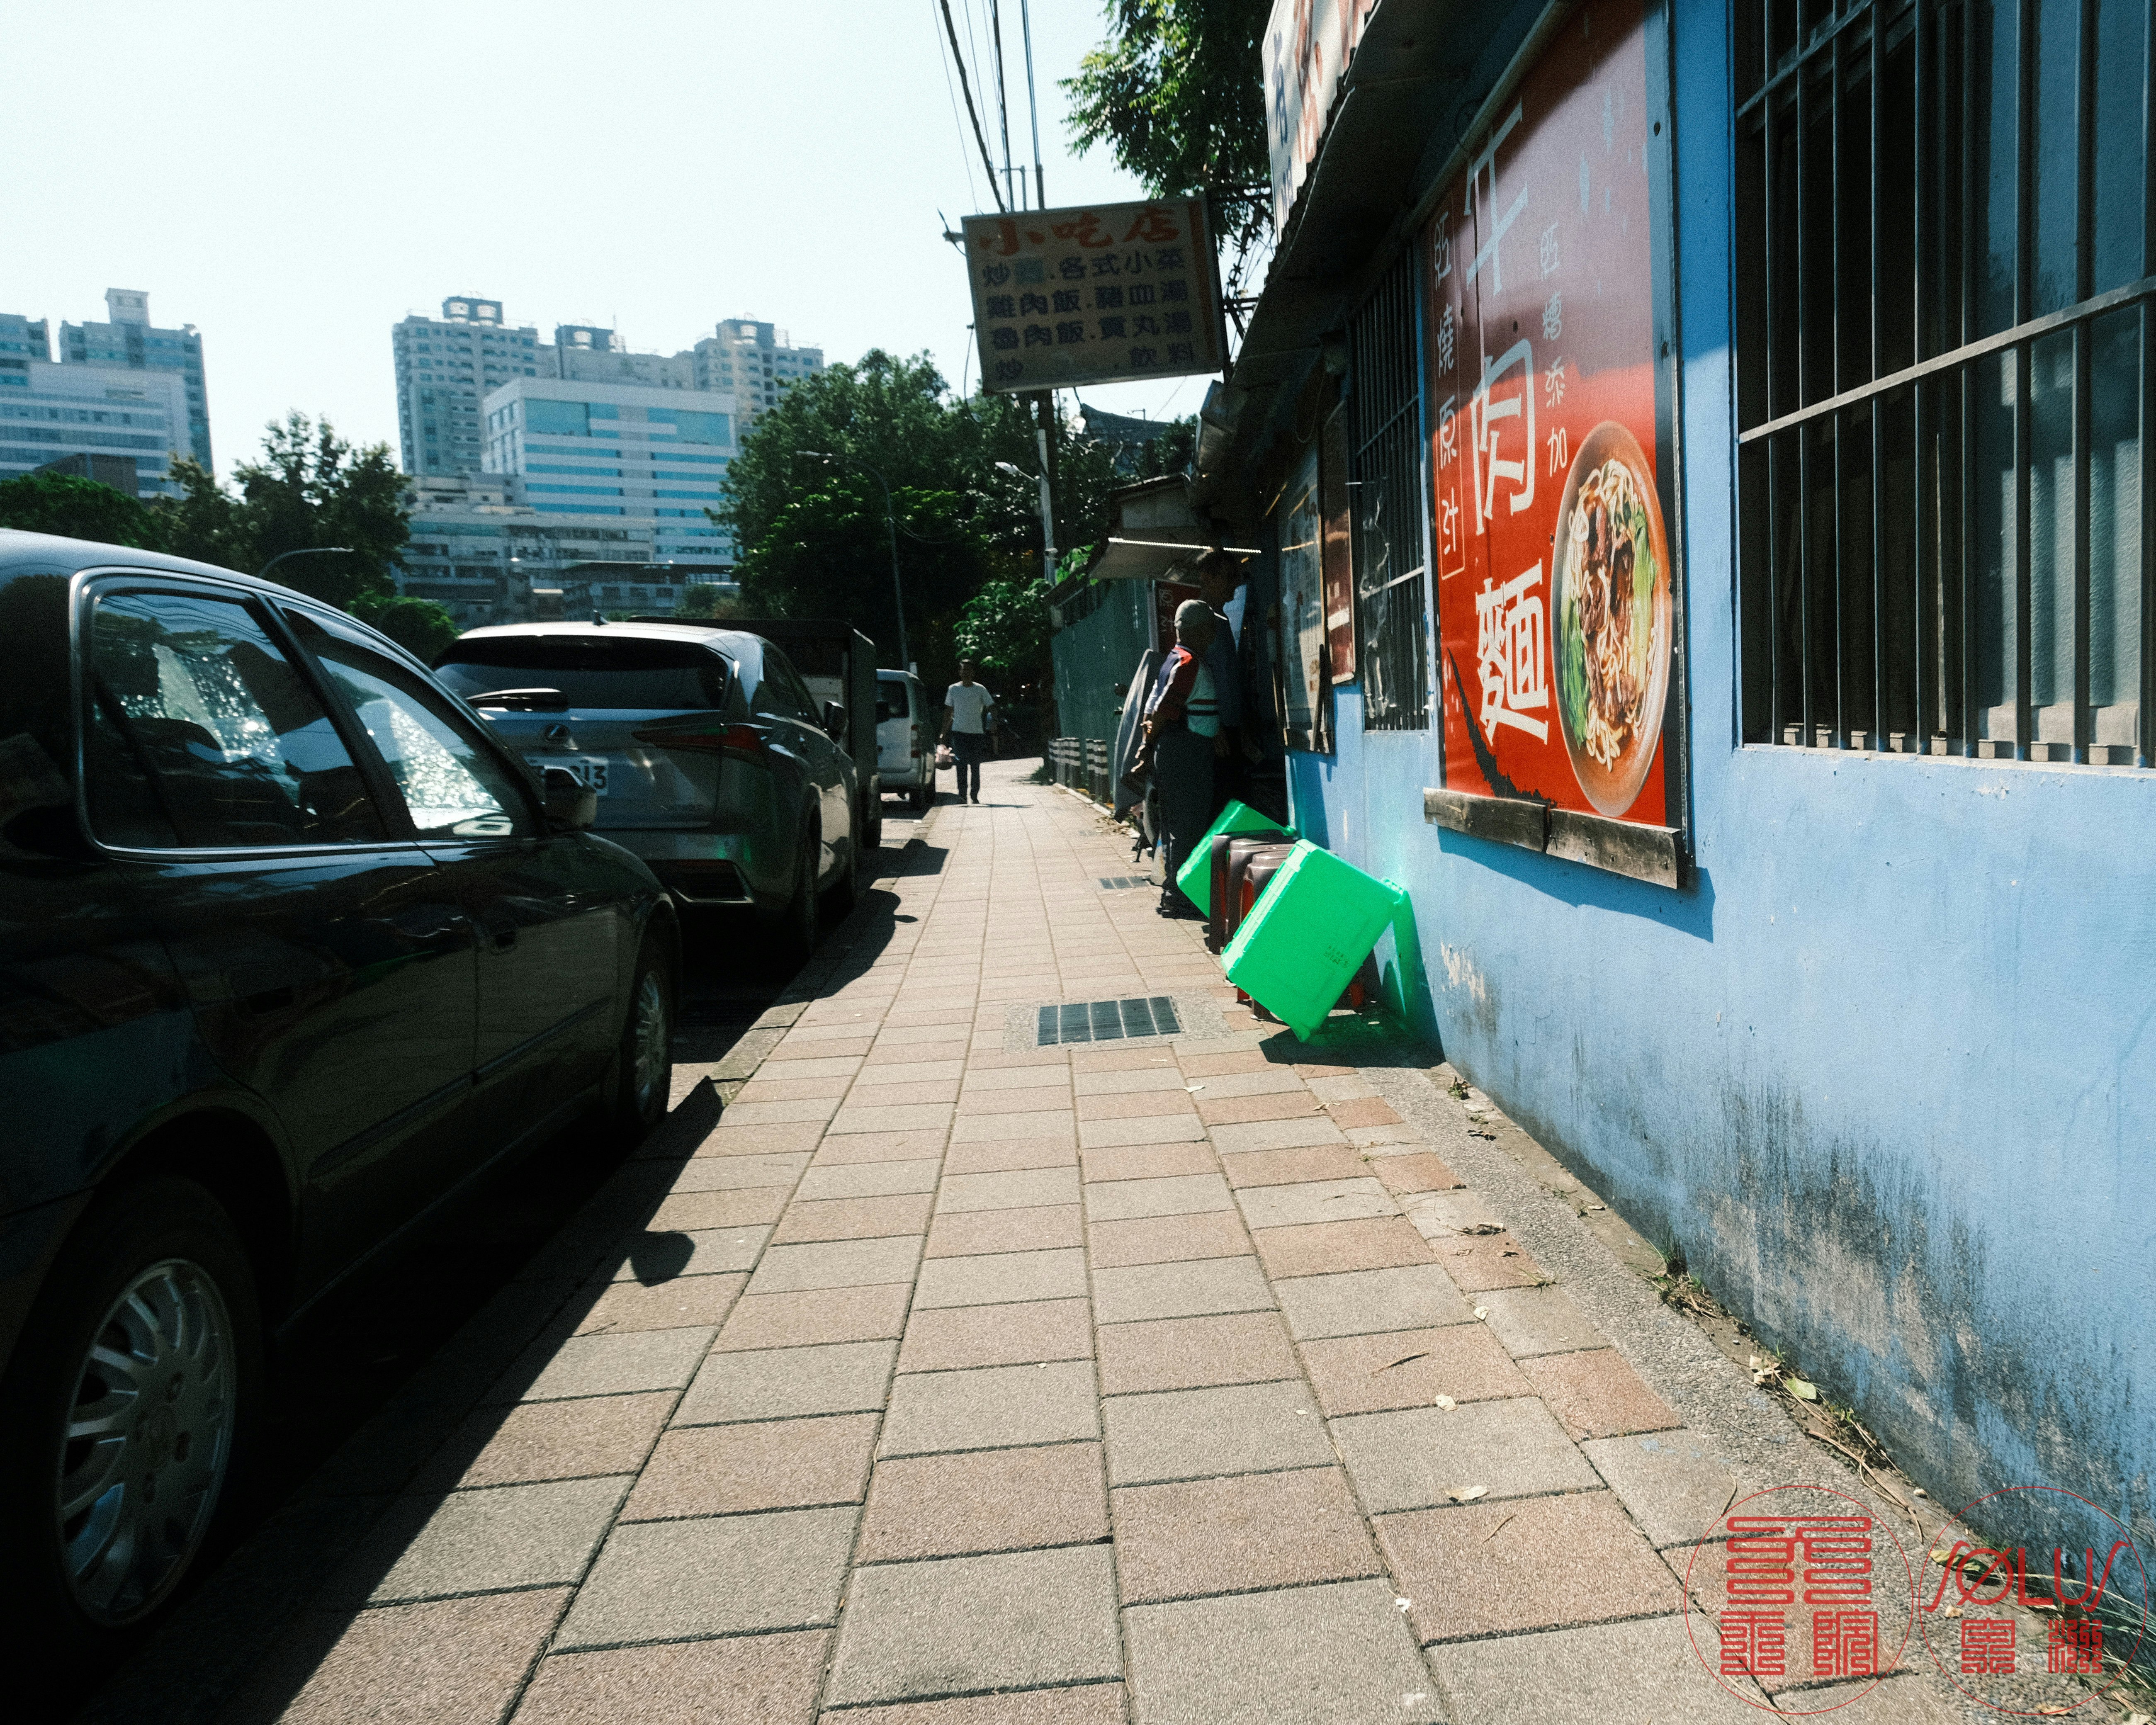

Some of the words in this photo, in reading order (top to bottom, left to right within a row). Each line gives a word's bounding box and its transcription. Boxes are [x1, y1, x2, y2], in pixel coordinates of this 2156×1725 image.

[979, 207, 1180, 256] 小吃店
[1434, 211, 1459, 556] 紅燒原汁
[1464, 97, 1550, 746] 牛肉麵
